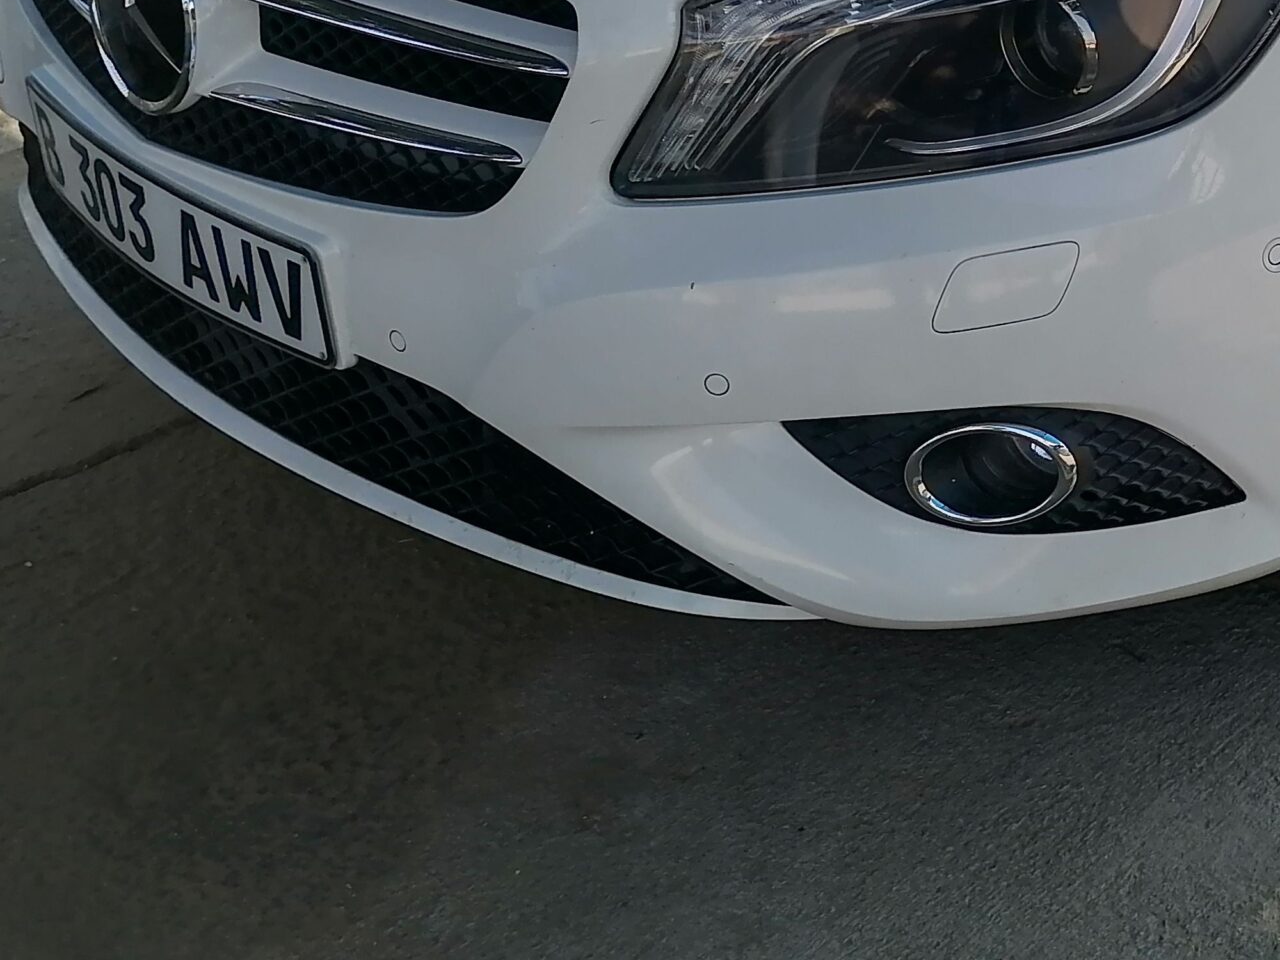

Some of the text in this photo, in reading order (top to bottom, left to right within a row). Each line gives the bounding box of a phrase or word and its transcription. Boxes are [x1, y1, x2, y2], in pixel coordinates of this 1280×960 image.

[35, 102, 304, 341] B 303 AWV
